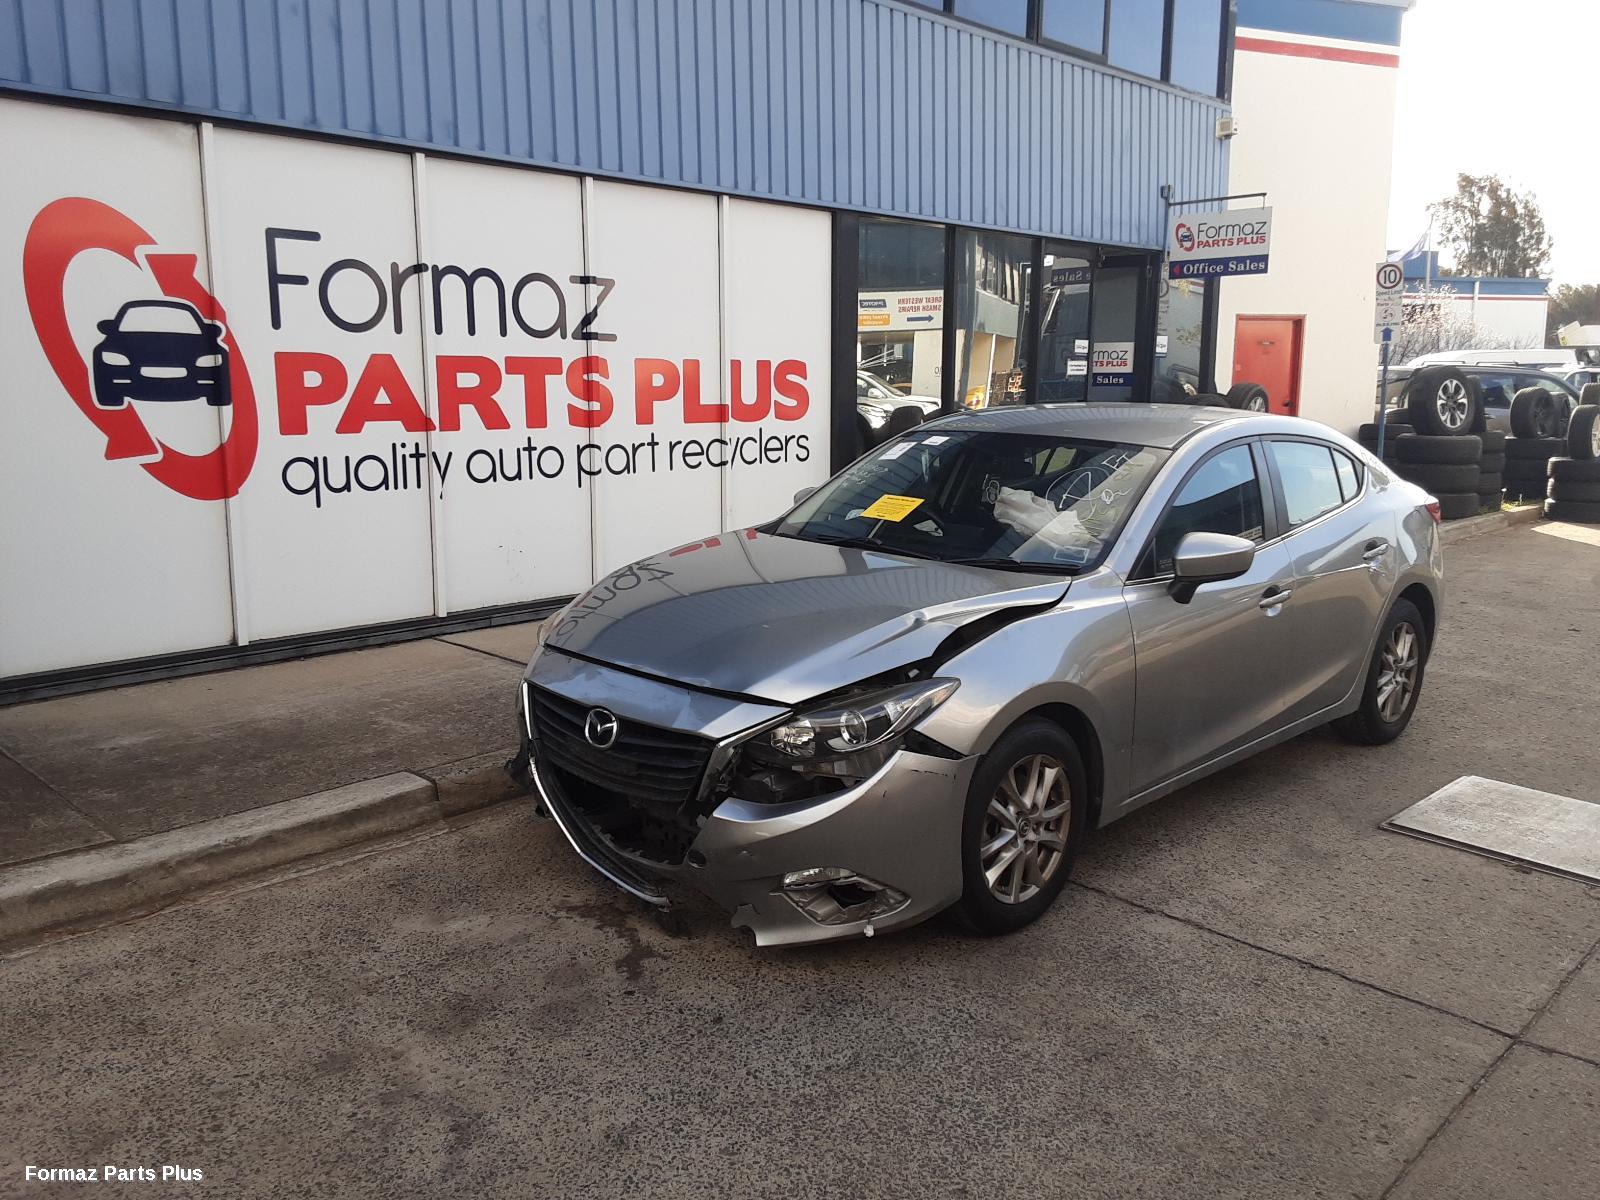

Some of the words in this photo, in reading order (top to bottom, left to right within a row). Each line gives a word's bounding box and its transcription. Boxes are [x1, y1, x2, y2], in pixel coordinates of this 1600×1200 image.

[1197, 221, 1267, 240] Formaz
[1196, 238, 1235, 249] PARTS
[1236, 235, 1266, 246] PLUS
[1183, 264, 1224, 274] Office
[1228, 260, 1266, 272] Sales
[265, 227, 618, 342] Formaz
[1383, 269, 1397, 284] 10
[1096, 376, 1124, 384] Sales
[275, 352, 612, 436] PARTS
[635, 358, 810, 422] PLUS
[282, 442, 453, 508] quality
[466, 438, 565, 484] auto
[577, 440, 660, 488] part
[668, 428, 810, 475] recyclers
